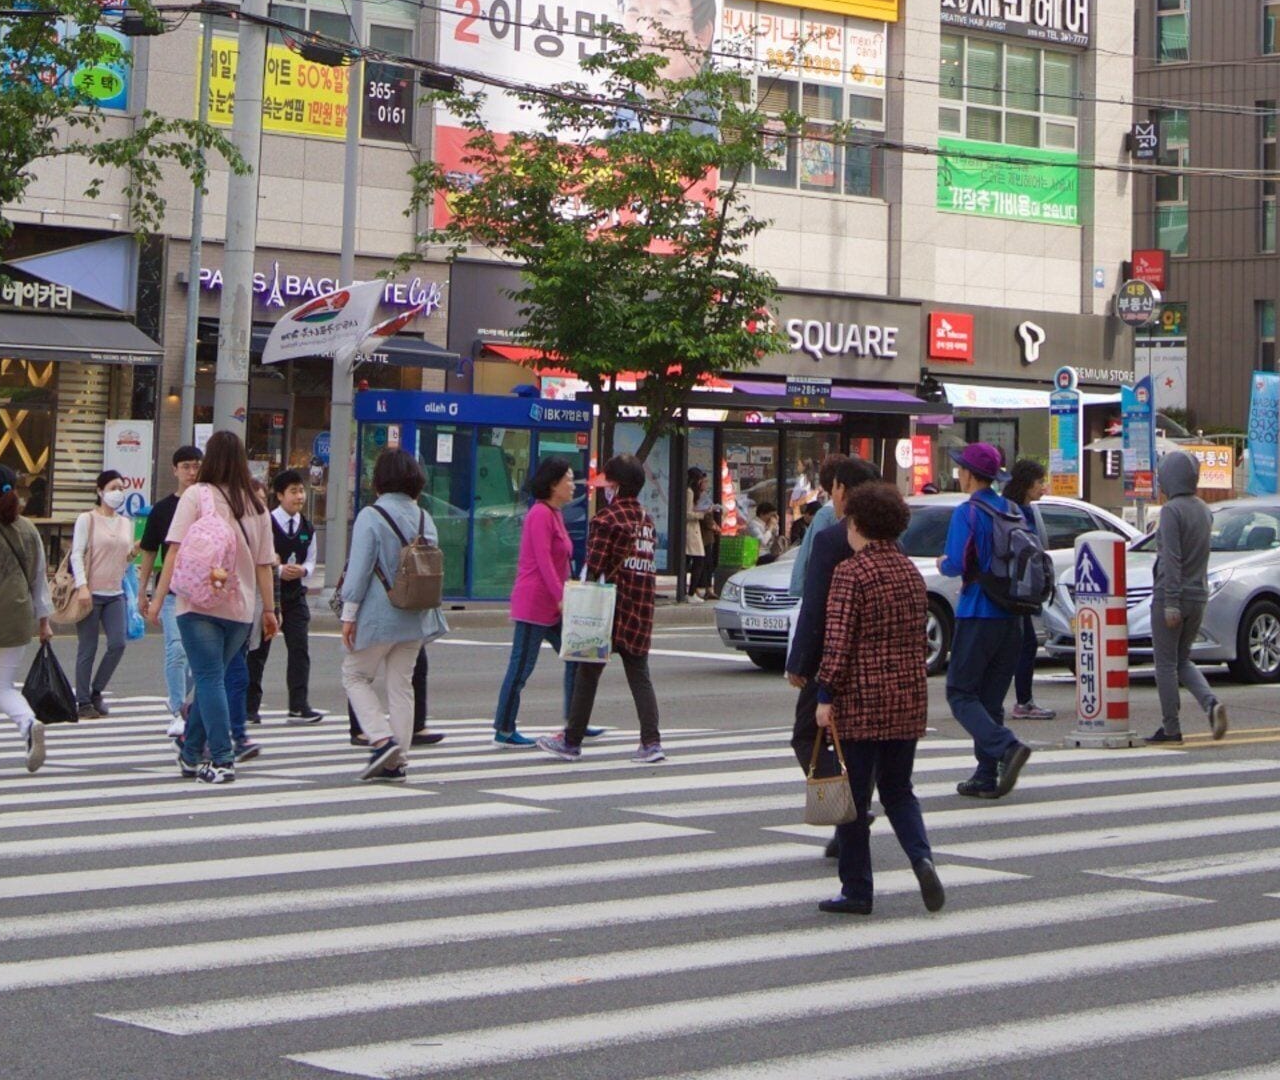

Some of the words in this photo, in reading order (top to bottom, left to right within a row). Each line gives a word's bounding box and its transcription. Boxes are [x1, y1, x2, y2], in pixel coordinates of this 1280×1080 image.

[82, 73, 118, 93] 주택
[296, 64, 332, 91] 50%
[368, 80, 396, 100] 365-
[308, 101, 333, 126] 1만원
[377, 105, 407, 125] 0161
[200, 268, 266, 293] PAS
[2, 281, 72, 310] 베이커리
[1118, 296, 1153, 312] 부동산
[786, 318, 899, 360] SQUARE
[1110, 369, 1135, 383] STORE
[801, 385, 816, 396] 286
[424, 401, 446, 413] olleh
[1080, 630, 1097, 714] 현대해상
